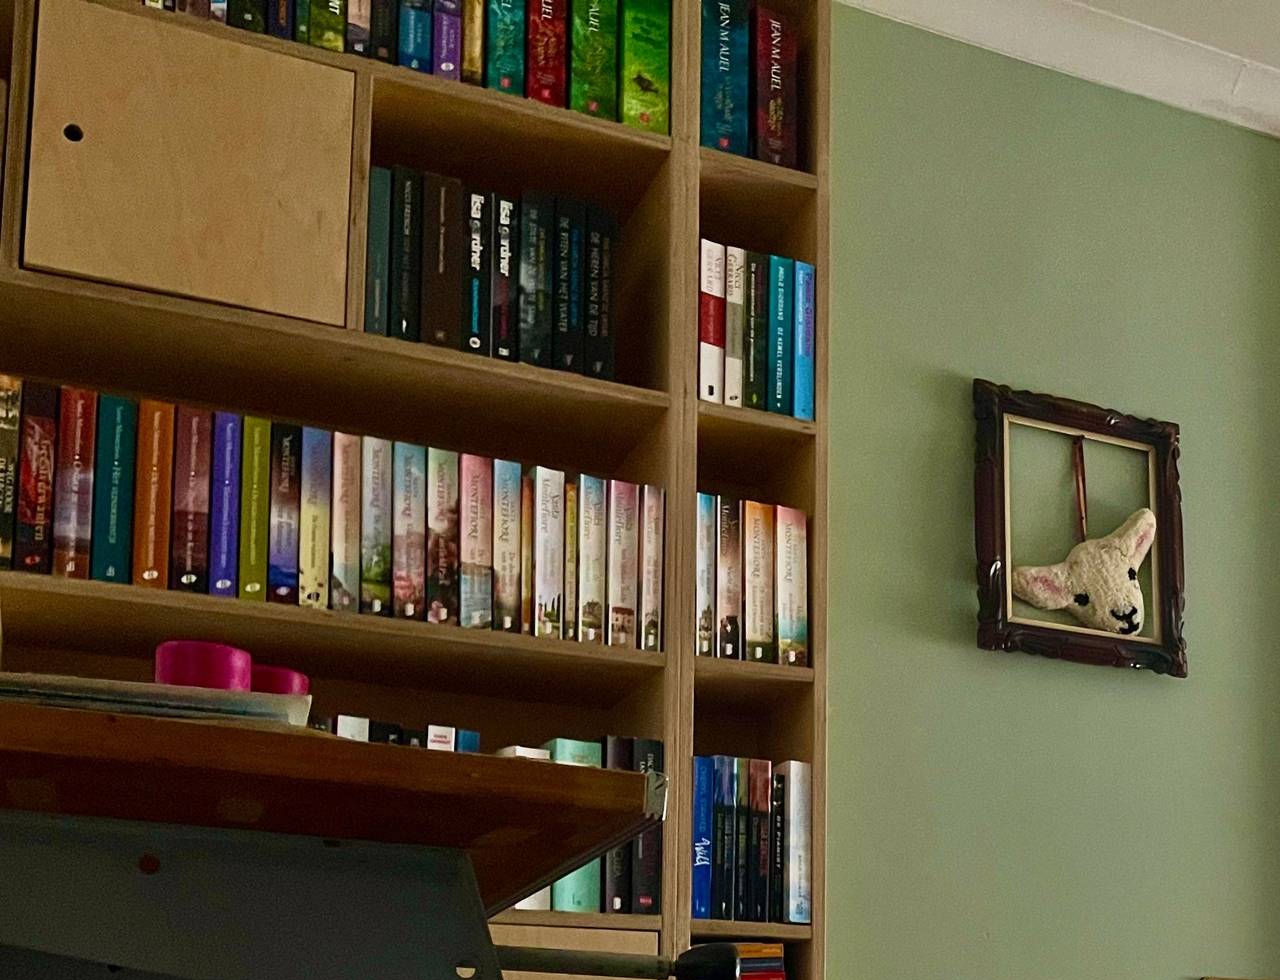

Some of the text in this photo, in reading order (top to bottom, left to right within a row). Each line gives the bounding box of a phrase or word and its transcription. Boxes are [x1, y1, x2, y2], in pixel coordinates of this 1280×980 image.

[718, 2, 731, 27] JEAN
[720, 30, 730, 41] M
[769, 19, 782, 46] JEAN
[719, 43, 730, 72] AUEL
[771, 47, 782, 58] M
[770, 60, 782, 91] AUEL
[470, 193, 484, 219] lisa
[499, 199, 513, 225] lisa
[559, 261, 569, 279] VAN
[589, 232, 599, 337] DE HEREN VAN DE TIJD
[559, 303, 569, 332] WATER
